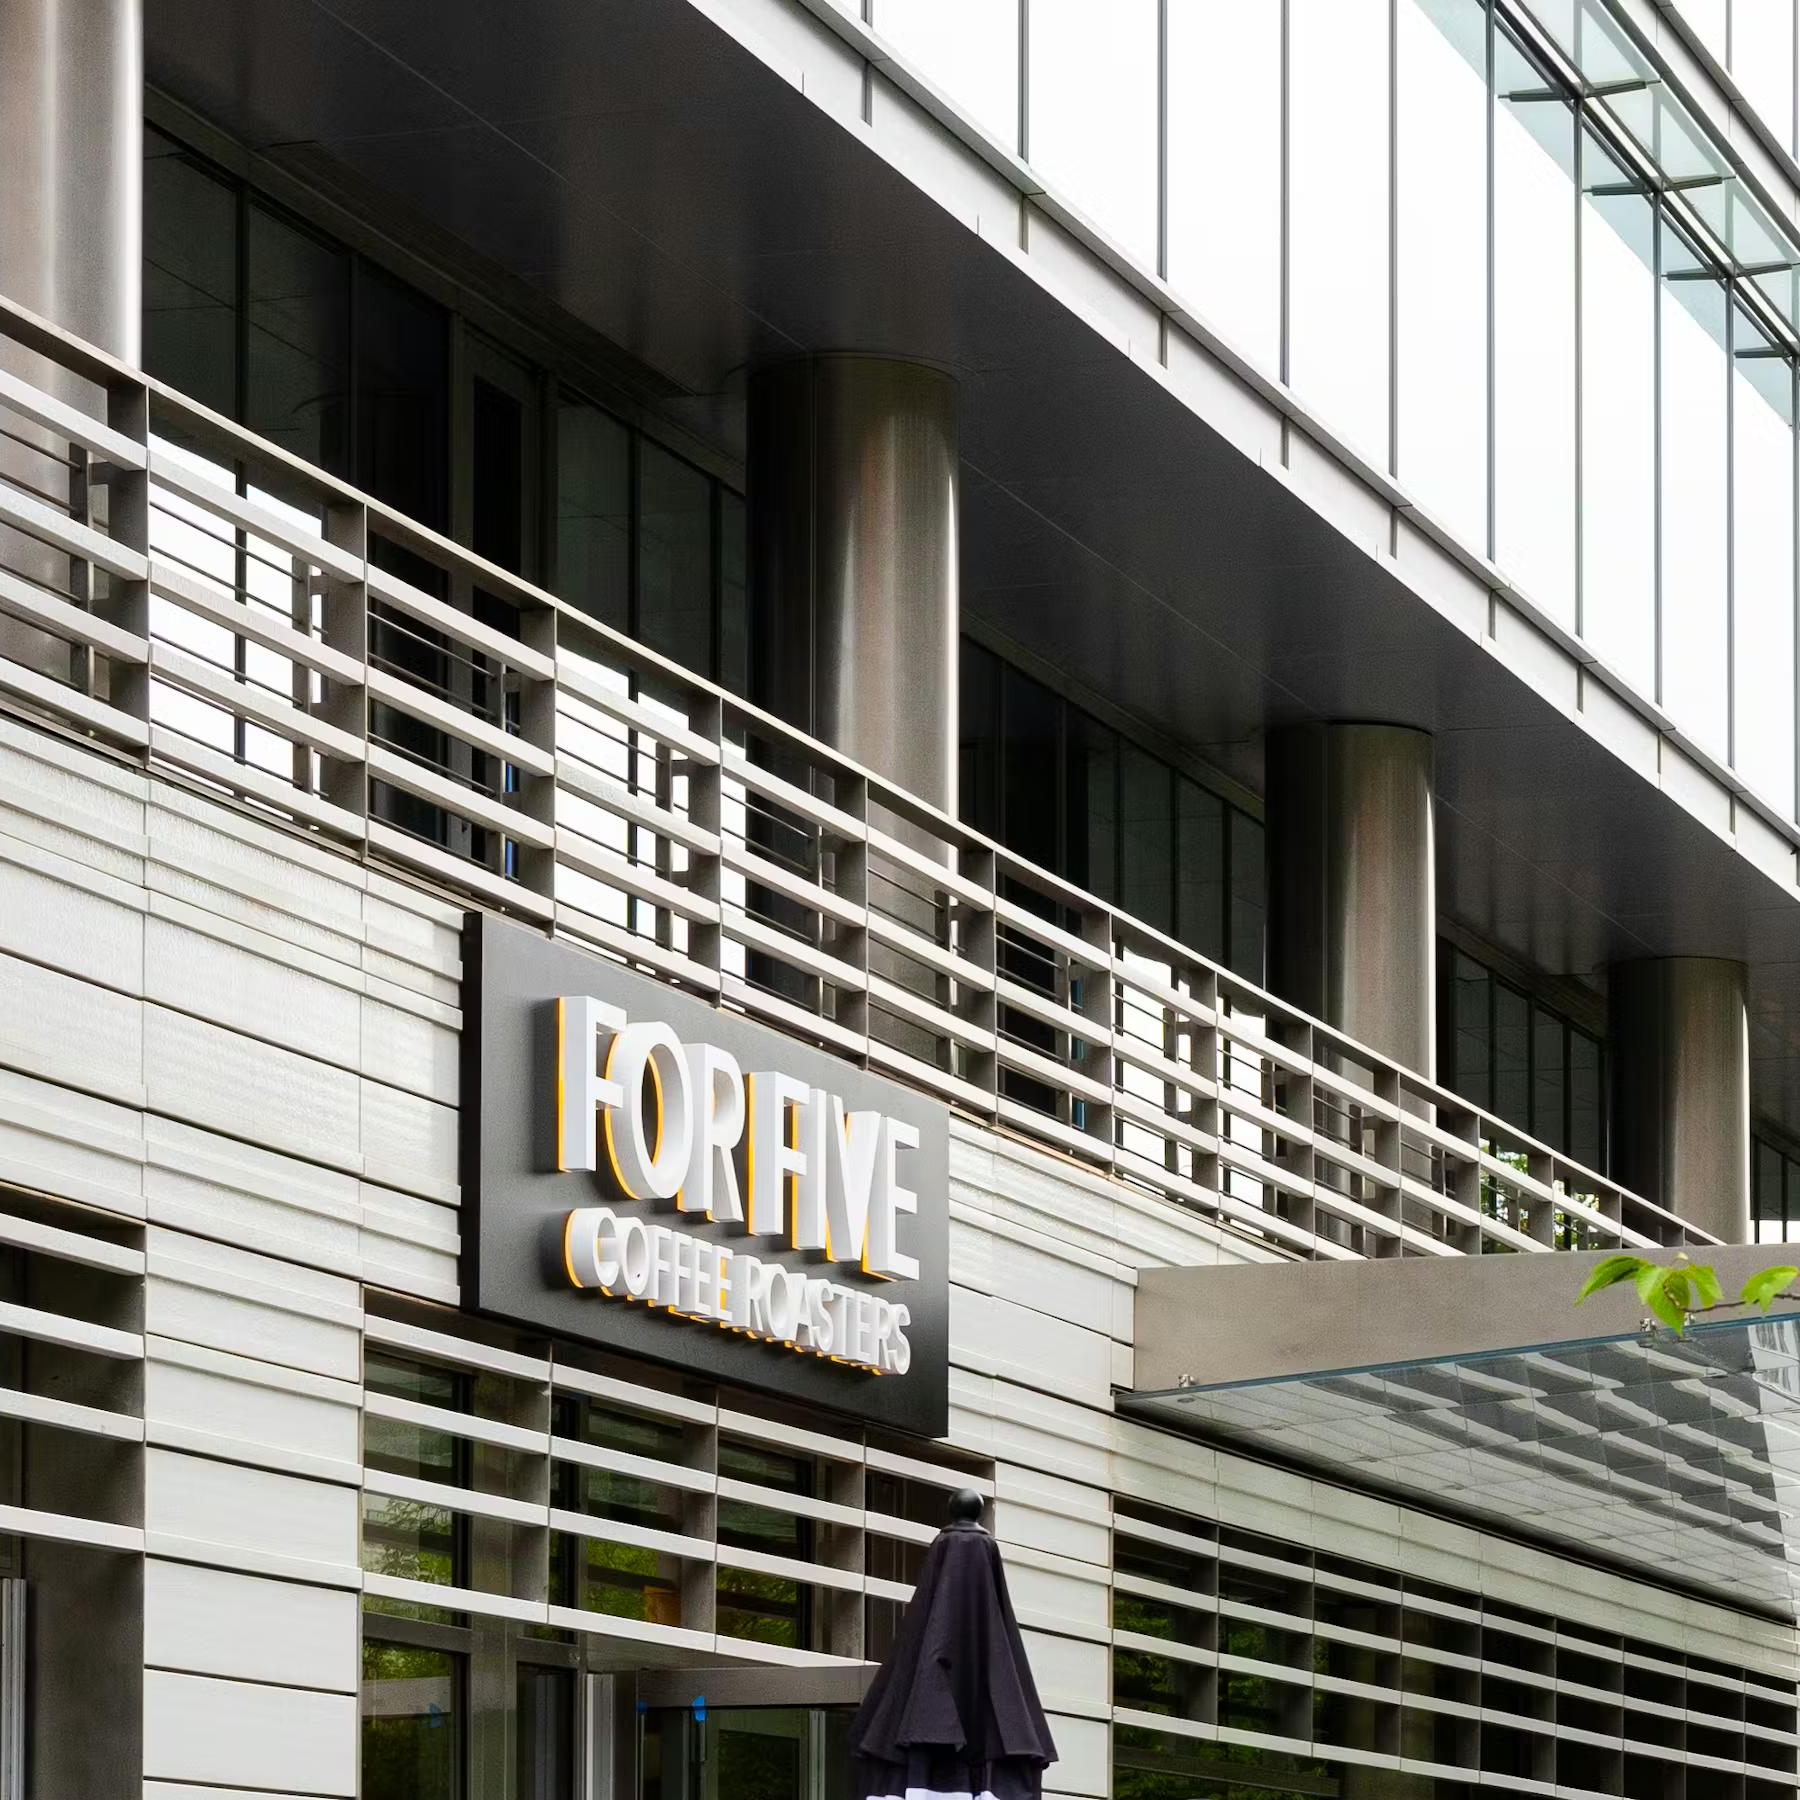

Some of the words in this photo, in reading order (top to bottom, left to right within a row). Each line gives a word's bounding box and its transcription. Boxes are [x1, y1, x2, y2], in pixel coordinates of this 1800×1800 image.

[556, 996, 745, 1221] FOR
[748, 1071, 920, 1281] FIVE
[564, 1207, 734, 1322] COFFEE
[724, 1255, 911, 1375] ROASTERS
